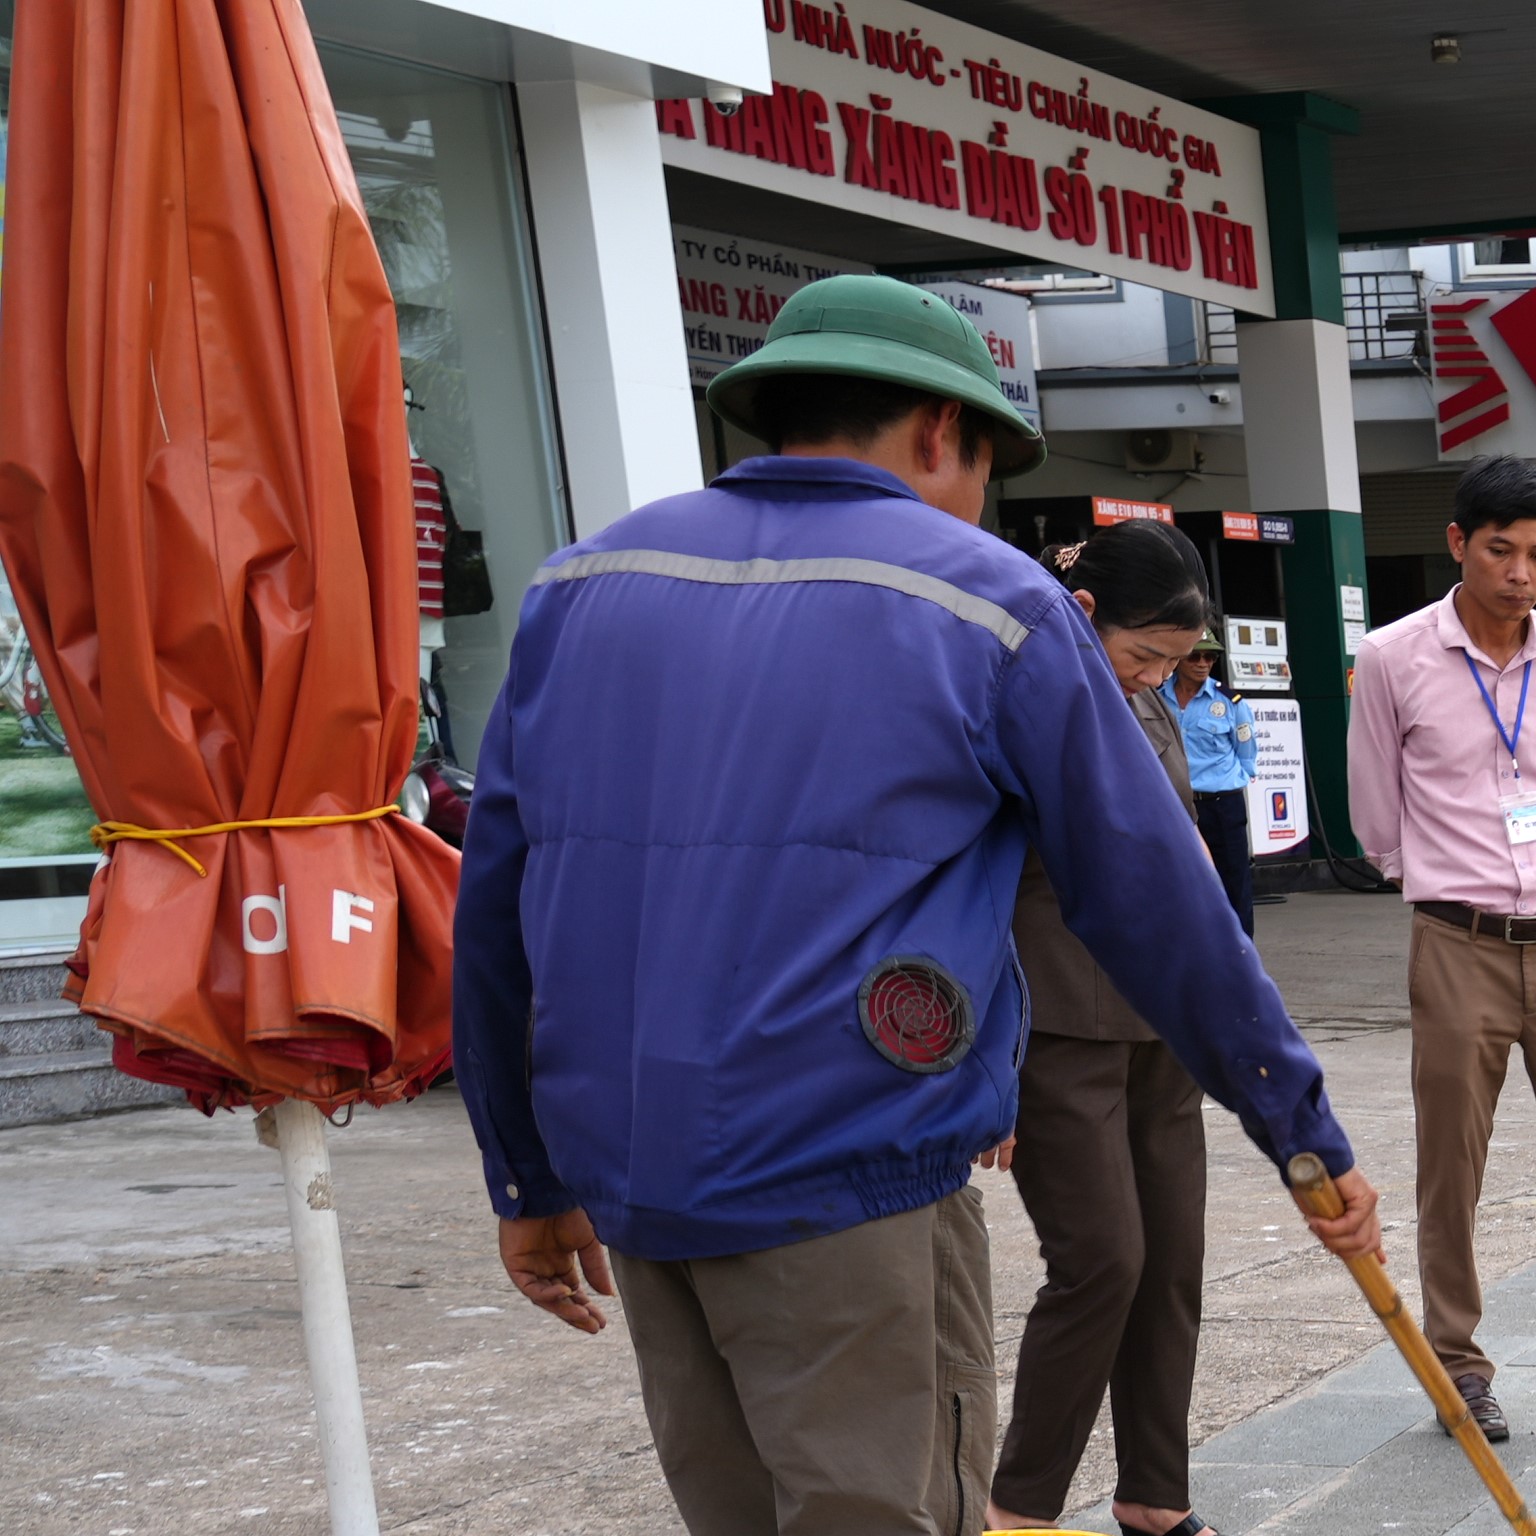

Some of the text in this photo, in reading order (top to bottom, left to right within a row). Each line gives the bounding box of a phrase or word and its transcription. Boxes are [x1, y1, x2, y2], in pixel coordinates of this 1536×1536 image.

[791, 0, 860, 60] NHÀ
[862, 27, 946, 86] NƯỚC
[964, 58, 1024, 112] TIÊU
[1028, 77, 1112, 142] CHUẨN
[1115, 106, 1180, 163] QUỐC
[1183, 134, 1222, 177] GIA
[837, 93, 960, 210] XĂNG
[960, 121, 1042, 231] DẦU
[1044, 146, 1098, 246] SỐ
[1099, 185, 1124, 254] 1
[1122, 169, 1192, 271] PHỔ
[1193, 199, 1258, 289] YÊN
[682, 240, 707, 260] TY
[714, 240, 741, 267] CỔ
[983, 330, 1015, 369] ÊN
